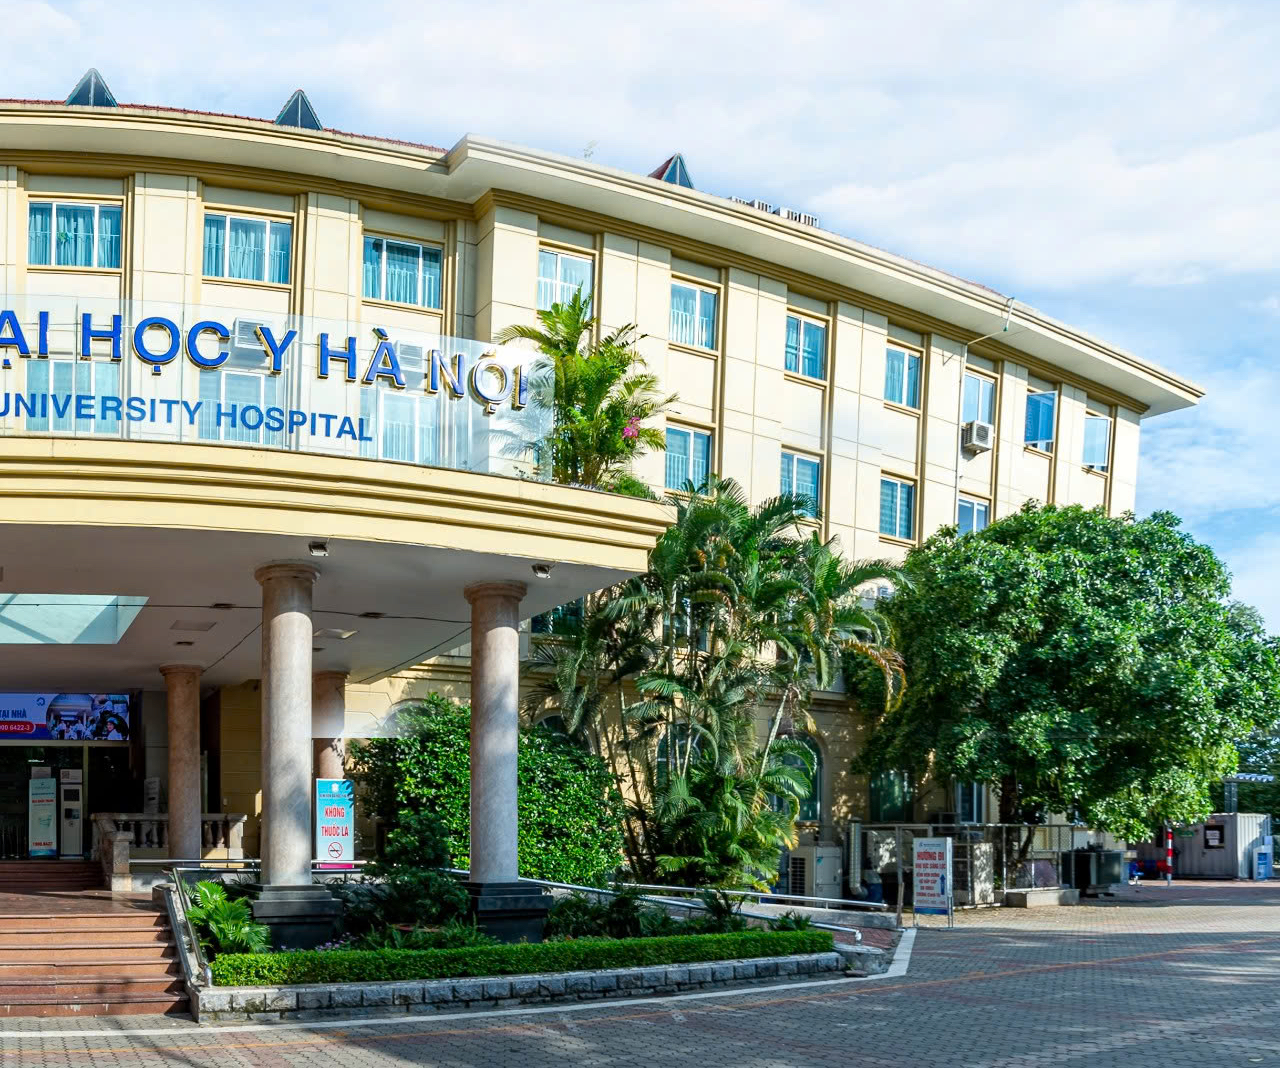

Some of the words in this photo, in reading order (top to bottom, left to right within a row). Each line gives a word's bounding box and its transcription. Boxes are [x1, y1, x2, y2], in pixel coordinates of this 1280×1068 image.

[80, 313, 231, 375] HỌC
[256, 326, 298, 375] Y
[318, 327, 406, 388] HÀ
[426, 347, 529, 415] NỘI
[216, 402, 374, 442] HOSPITAL
[324, 805, 345, 818] KHÔNG
[321, 822, 340, 837] THUỐC
